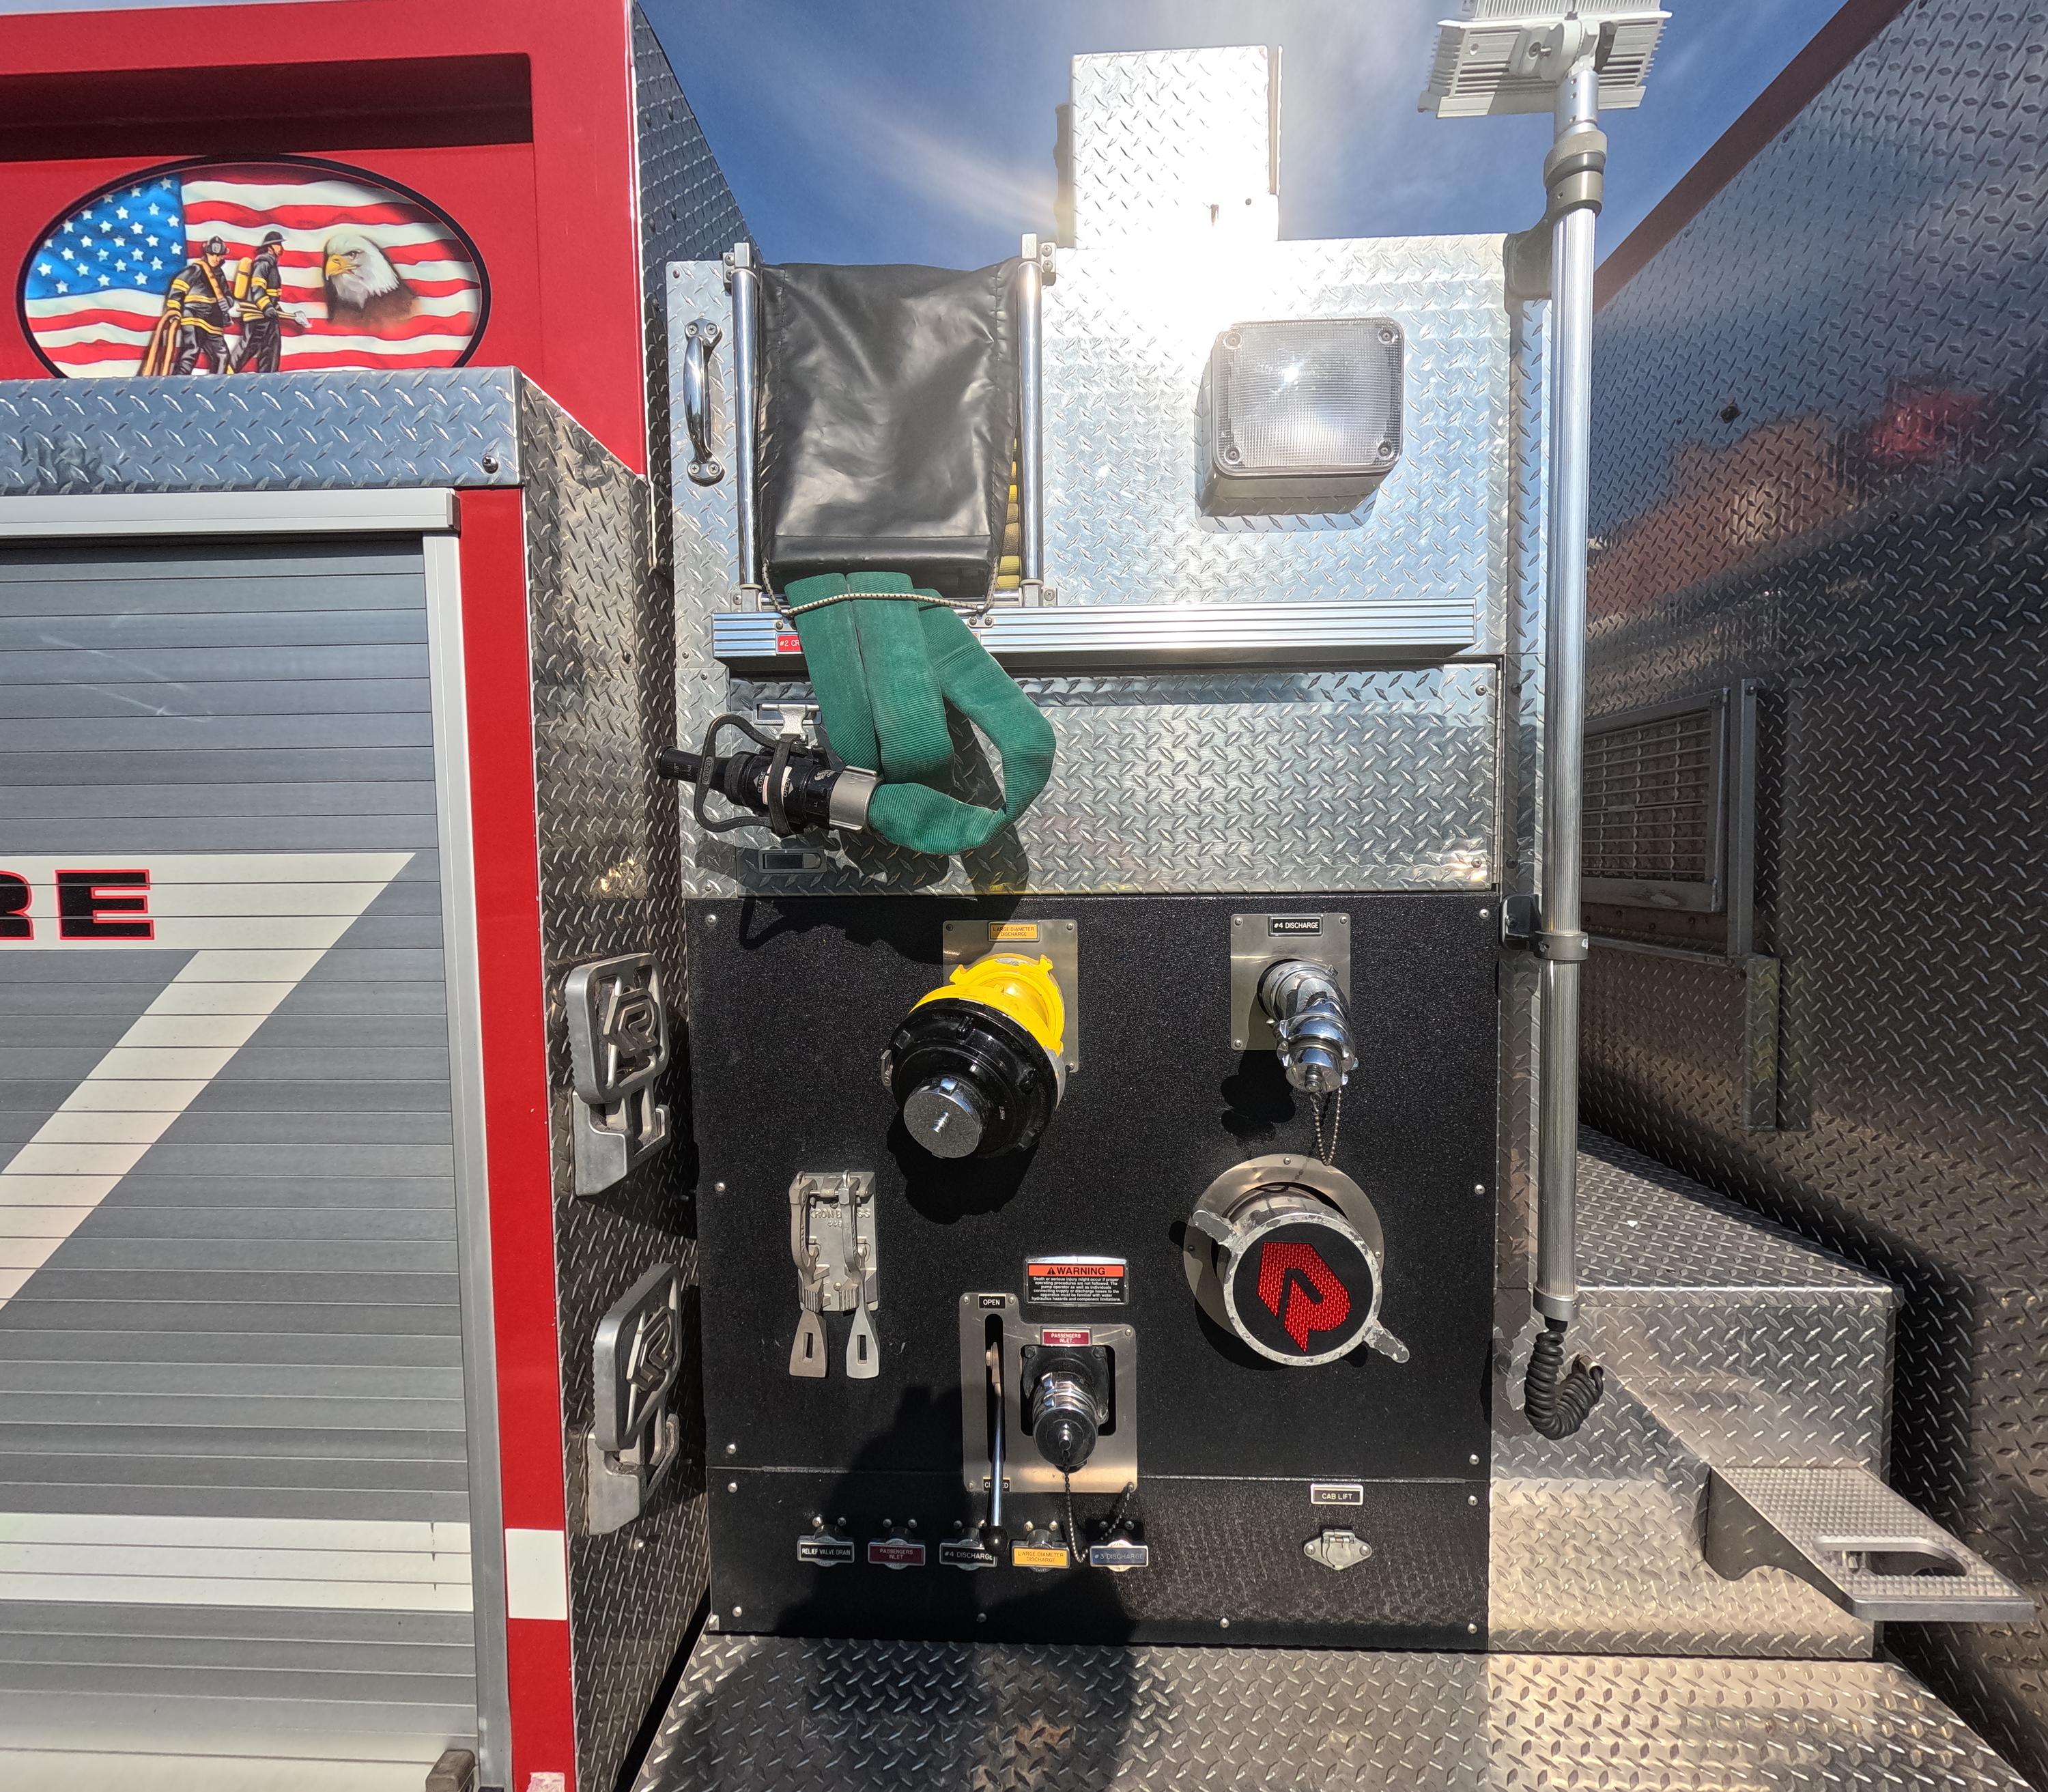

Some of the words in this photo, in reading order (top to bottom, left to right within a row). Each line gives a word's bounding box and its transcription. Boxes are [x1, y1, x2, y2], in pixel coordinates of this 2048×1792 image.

[758, 771, 766, 793] CLOSE
[1057, 1267, 1105, 1275] WARNING
[956, 1552, 993, 1561] DISCHARGE
